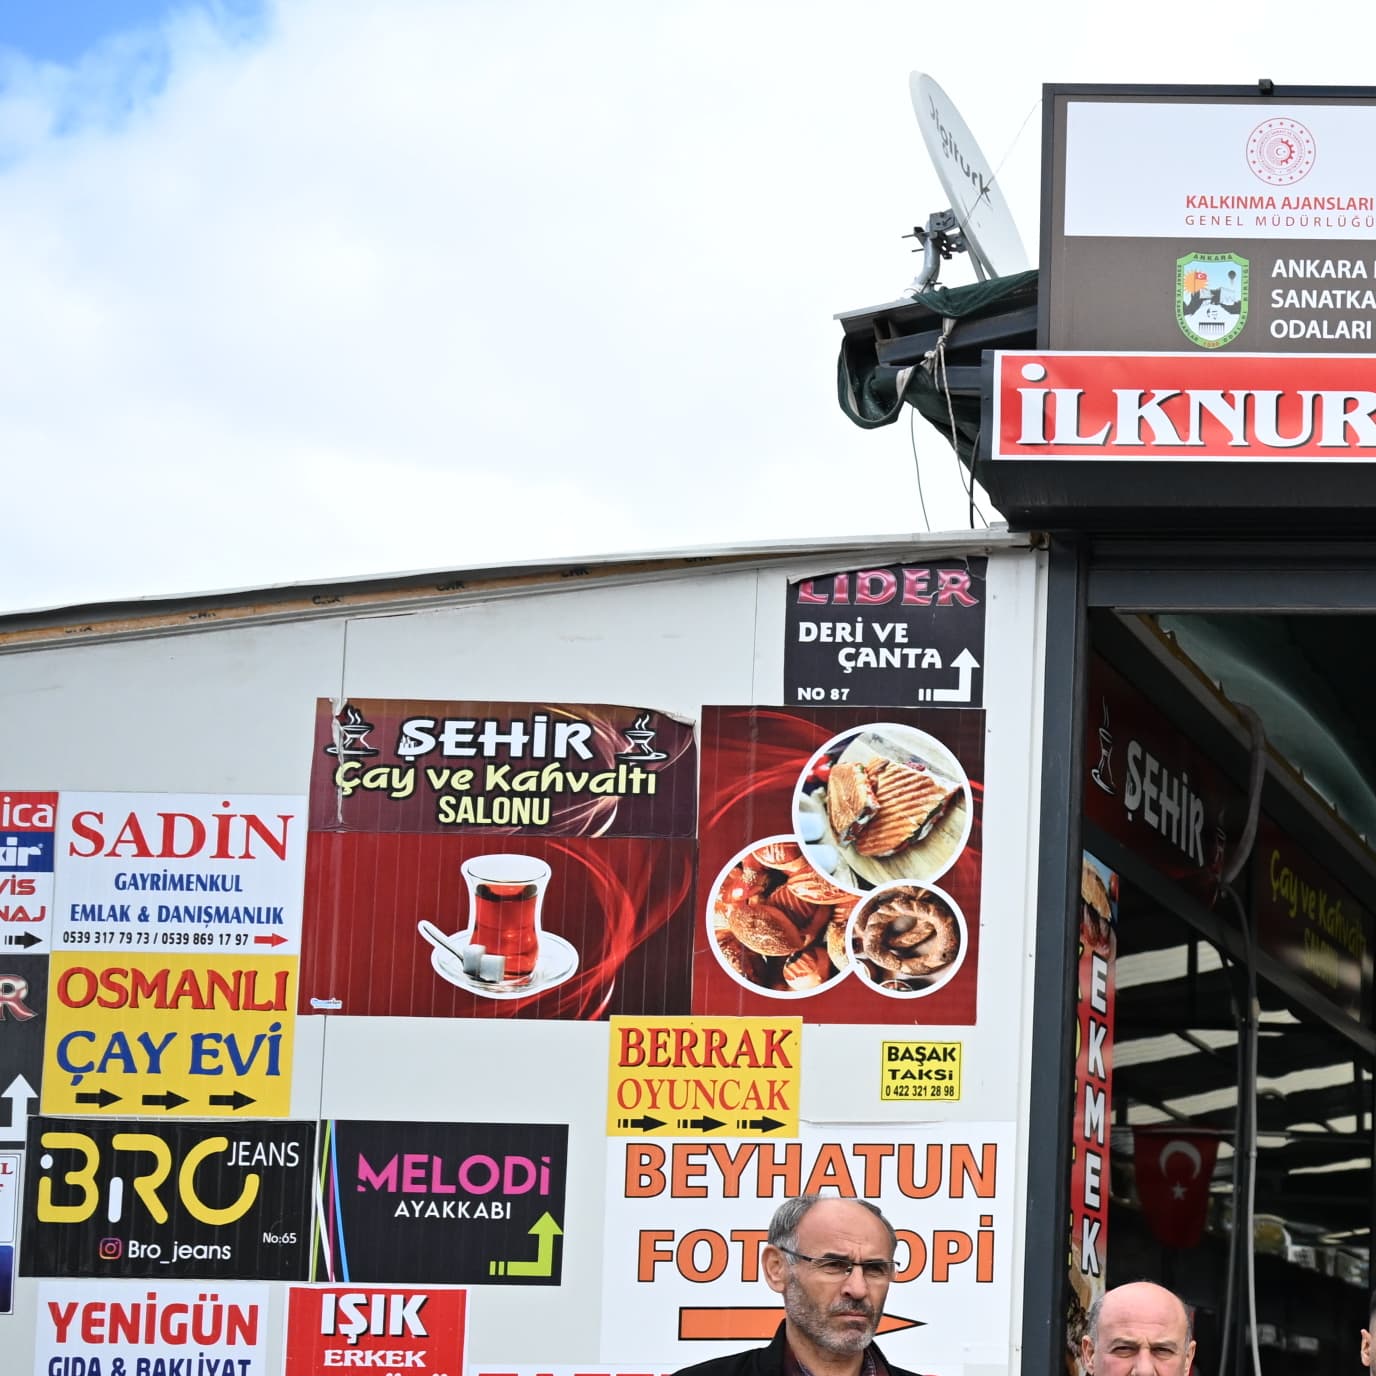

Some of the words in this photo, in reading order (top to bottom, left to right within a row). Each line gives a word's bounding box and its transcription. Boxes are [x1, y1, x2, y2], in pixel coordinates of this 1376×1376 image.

[1186, 195, 1276, 210] KALKINMA
[1281, 196, 1374, 211] AJANSLARI
[1185, 215, 1244, 226] GENEL
[1255, 214, 1375, 228] MÜDÜRLÜĞÜ
[1271, 259, 1368, 281] ANKARA
[1270, 319, 1373, 341] ODALARI
[798, 616, 864, 644] DERİ
[871, 622, 909, 644] VE
[837, 646, 943, 673] ÇANTA
[797, 687, 825, 702] NO
[829, 687, 850, 702] 87
[397, 713, 595, 763] ŞEHİR
[335, 760, 414, 797] Çay
[426, 768, 472, 790] ve
[485, 763, 658, 796] Kahvaltı
[438, 795, 551, 826] SALONU
[69, 800, 295, 861] SADİN
[114, 868, 243, 893] GAYRİMENKUL
[70, 904, 131, 923] EMLAK
[138, 907, 150, 922] &
[157, 905, 284, 928] DANIŞMANLIK
[56, 966, 290, 1012] OSMANLI
[56, 1030, 178, 1086] ÇAY
[188, 1022, 282, 1077] EVİ
[617, 1025, 793, 1069] BERRAK
[887, 1045, 957, 1067] BAŞAK
[616, 1078, 791, 1112] OYUNCAK
[893, 1085, 910, 1096] 422
[912, 1085, 927, 1096] 321
[930, 1085, 941, 1097] 28
[944, 1085, 955, 1097] 98
[36, 1132, 261, 1226] BRO
[227, 1141, 300, 1168] JEANS
[623, 1143, 997, 1199] BEYHATUN
[393, 1200, 512, 1220] AYAKKABI
[262, 1232, 297, 1244] No:65
[127, 1240, 232, 1264] Bro_jeans
[47, 1291, 259, 1347] YENİGÜN
[320, 1293, 428, 1344] IŞIK
[323, 1349, 426, 1368] ERKEK
